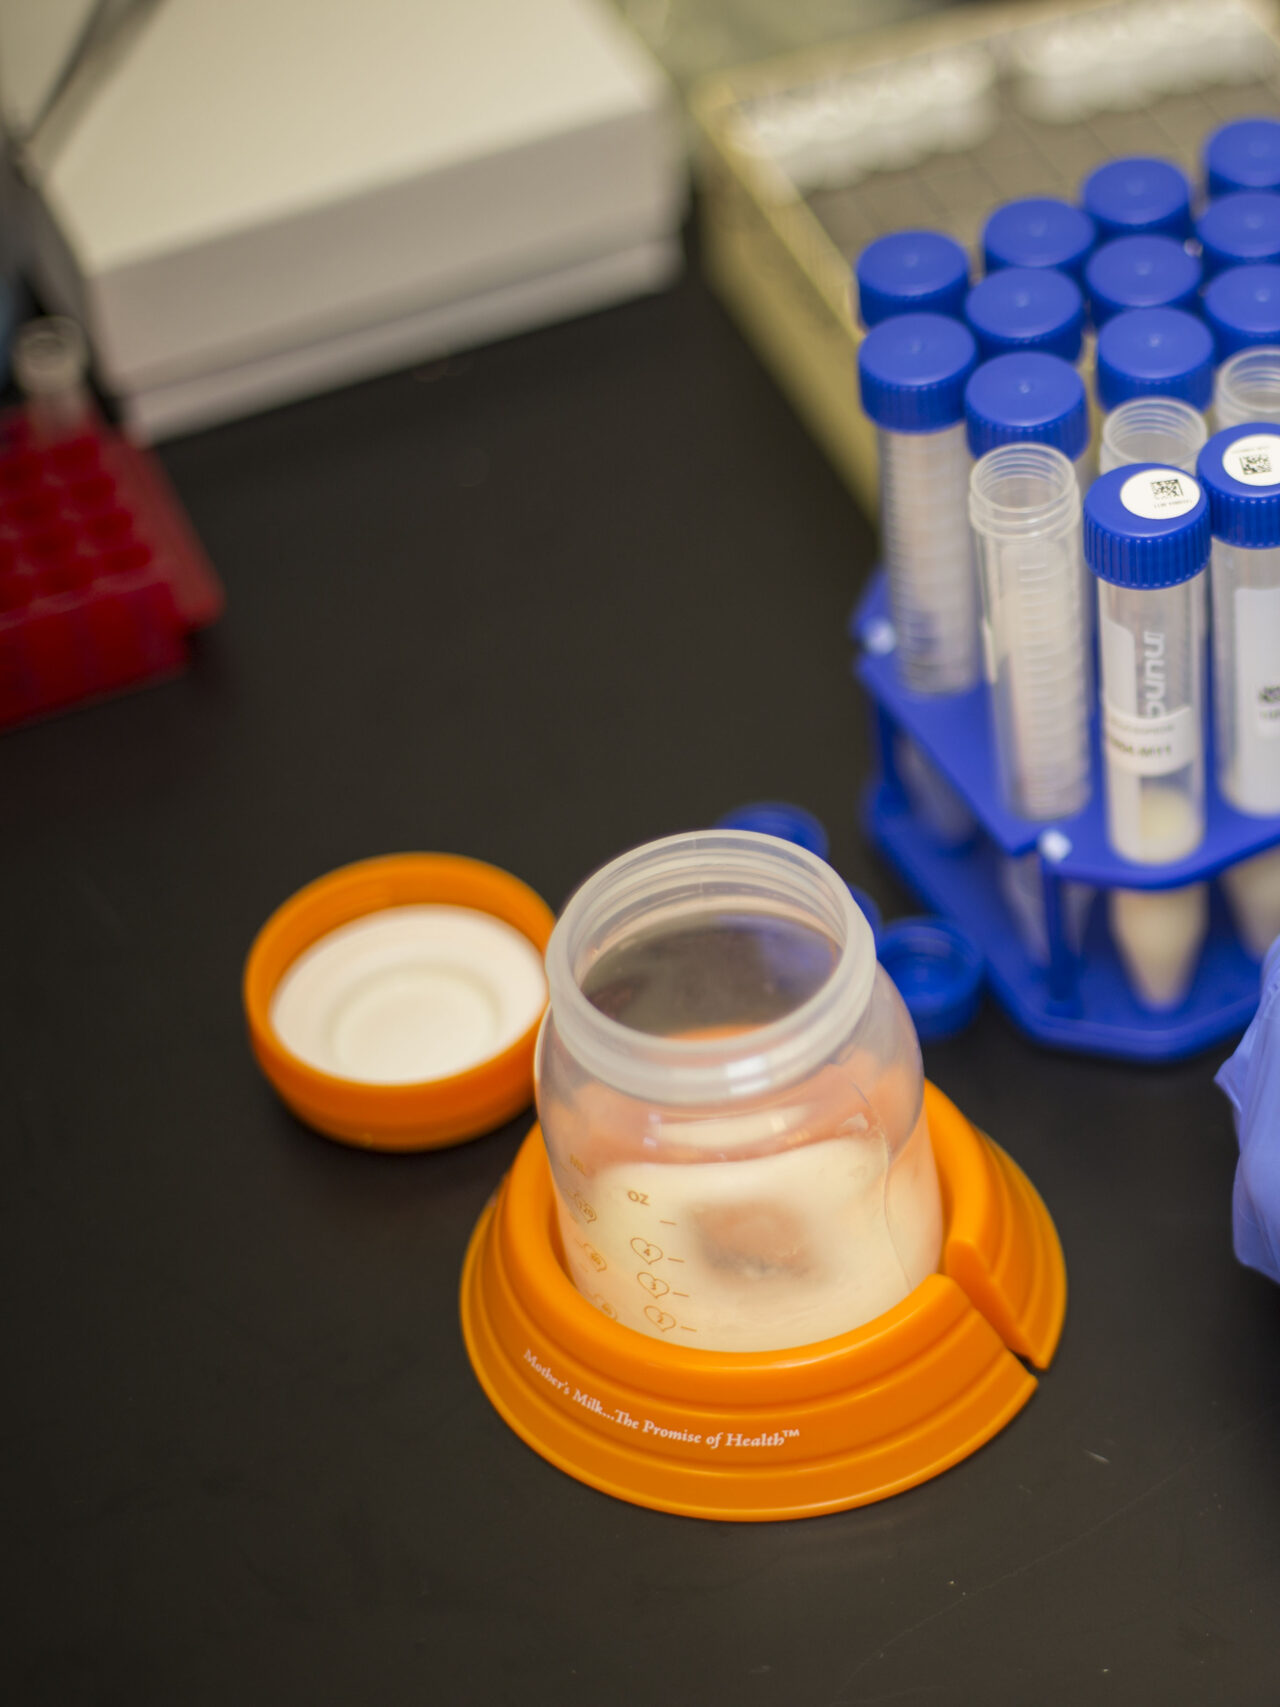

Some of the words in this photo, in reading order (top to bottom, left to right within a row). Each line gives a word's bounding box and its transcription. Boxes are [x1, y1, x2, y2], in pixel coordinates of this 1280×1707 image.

[523, 1349, 570, 1395] Mother's
[642, 1420, 701, 1444] Promise
[706, 1432, 723, 1449] of
